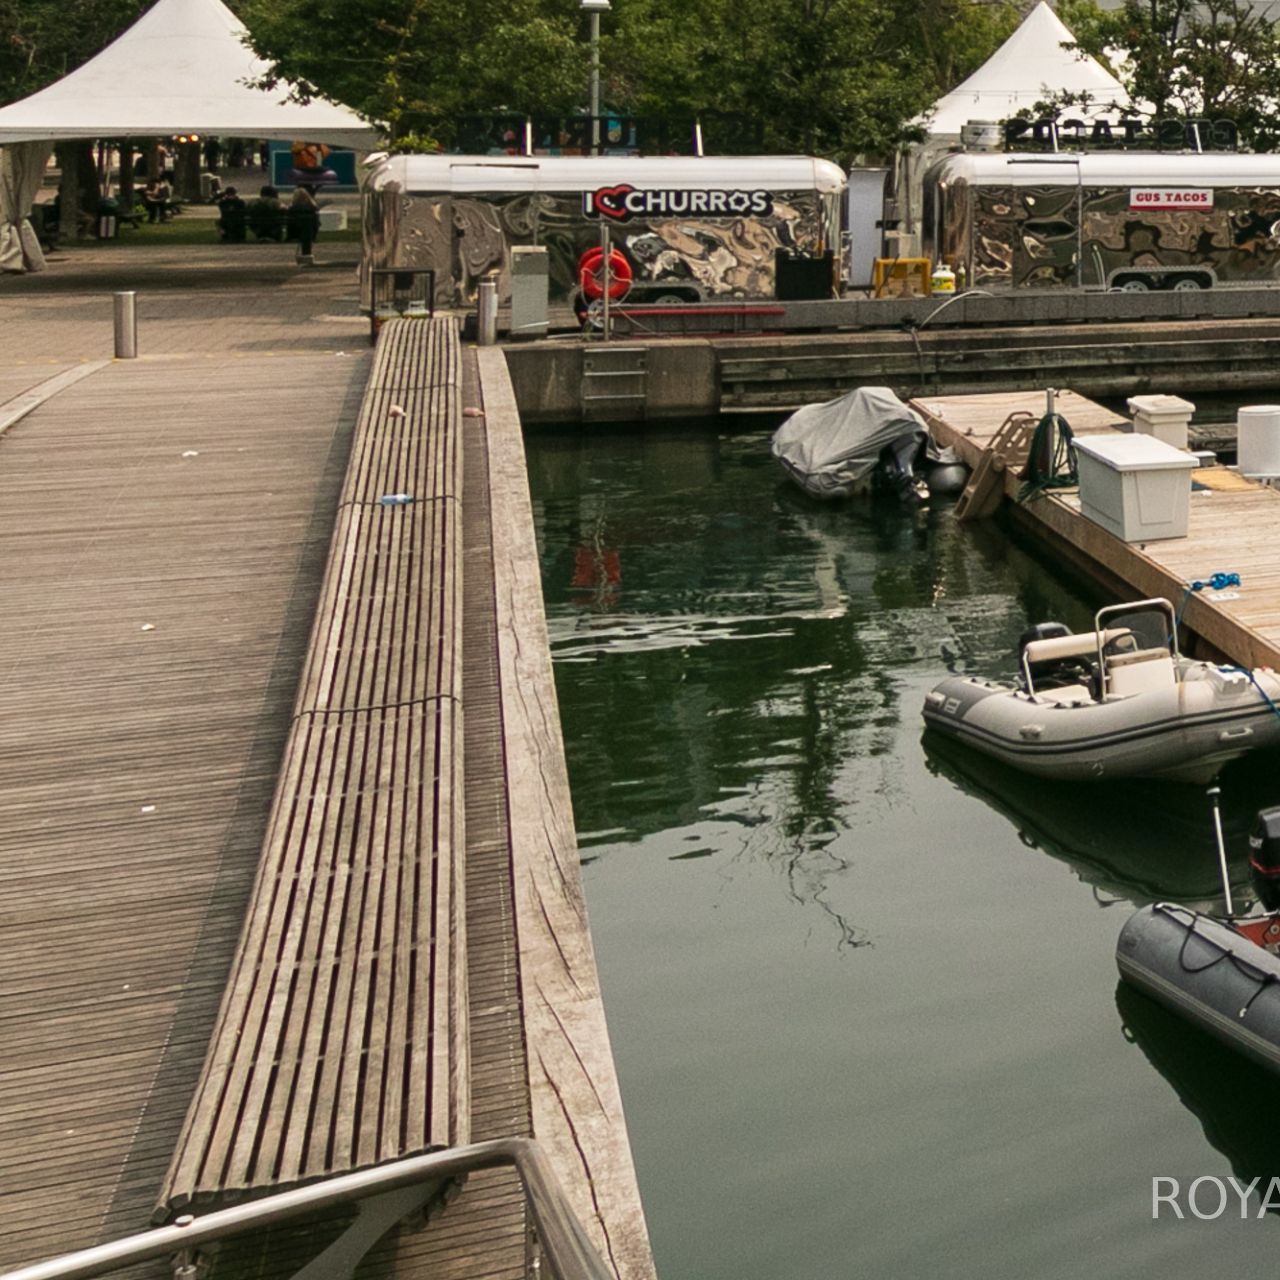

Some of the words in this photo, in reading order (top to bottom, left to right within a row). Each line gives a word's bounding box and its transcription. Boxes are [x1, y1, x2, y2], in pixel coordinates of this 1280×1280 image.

[625, 191, 767, 212] CHURROS
[1136, 193, 1160, 202] GUS
[1165, 193, 1208, 202] TACOS
